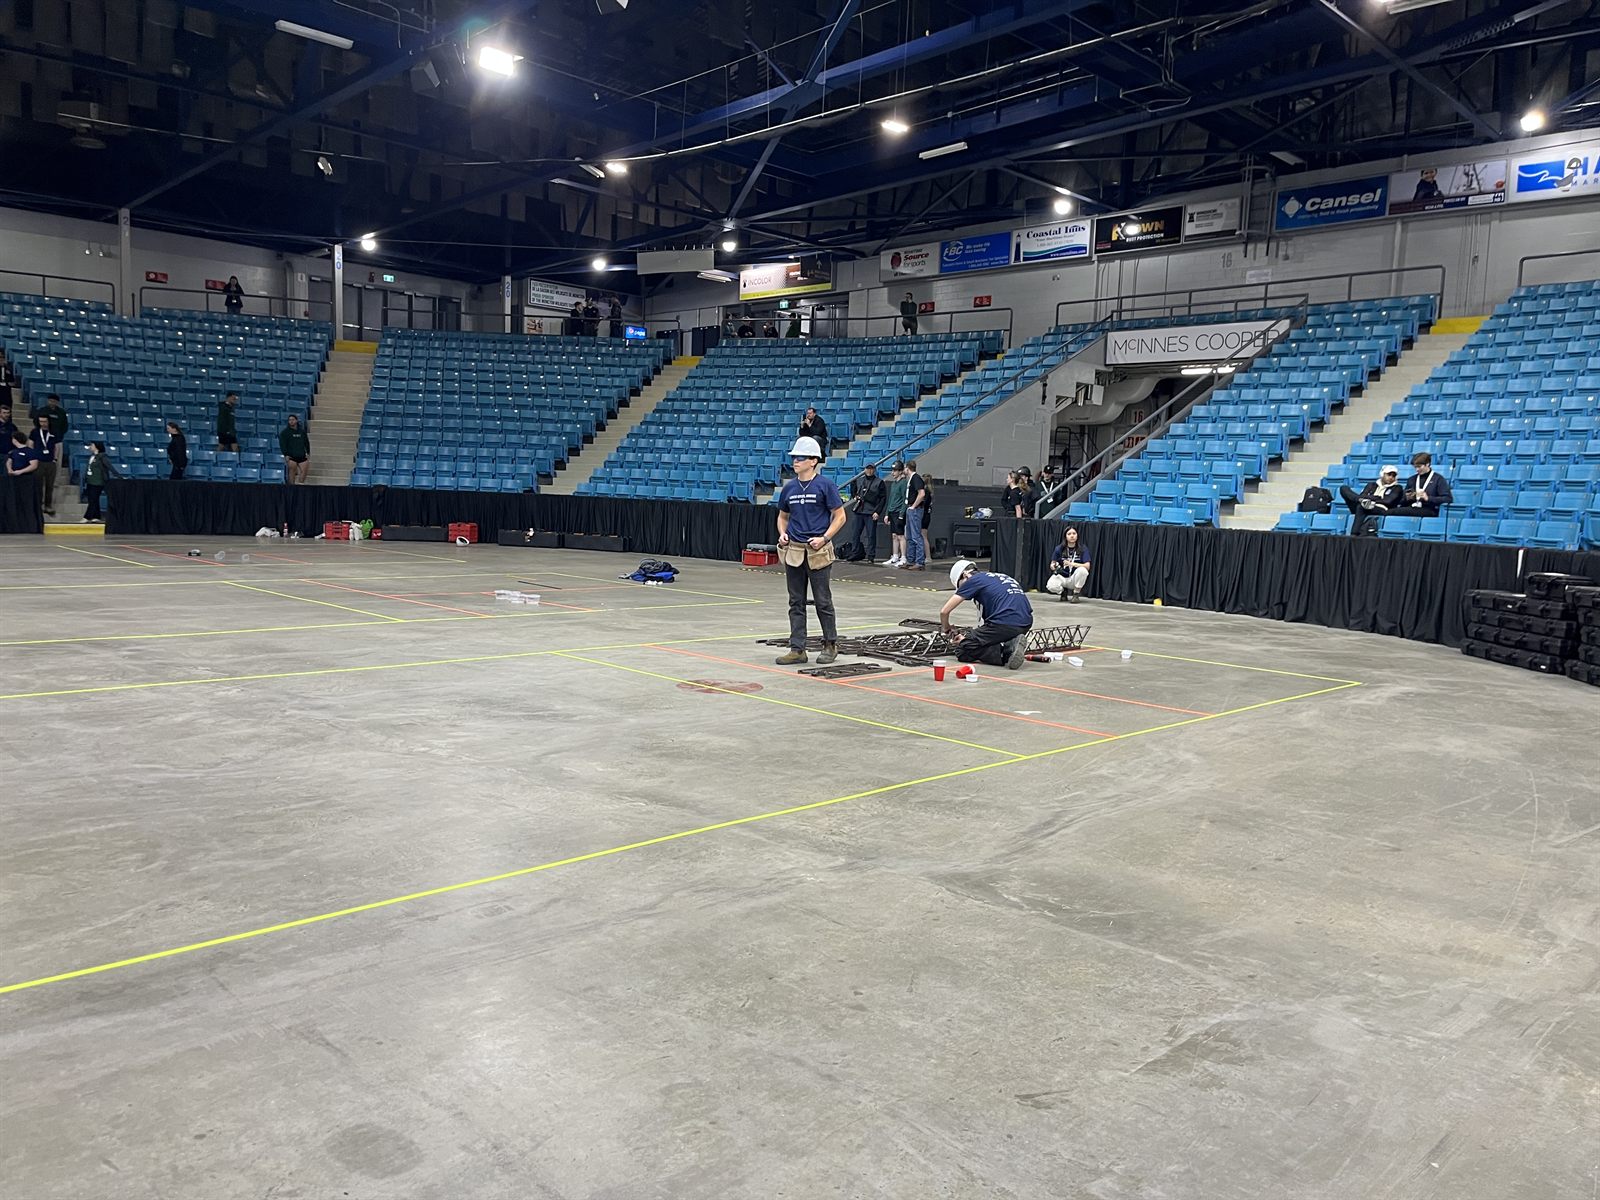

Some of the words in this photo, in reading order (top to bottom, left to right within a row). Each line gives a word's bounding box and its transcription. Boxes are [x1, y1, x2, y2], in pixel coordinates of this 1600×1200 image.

[1305, 188, 1382, 211] Cansel
[1027, 227, 1061, 239] Coastal
[1065, 224, 1086, 234] Inns
[904, 253, 929, 261] Source
[506, 281, 511, 298] 20
[1134, 410, 1144, 423] 16
